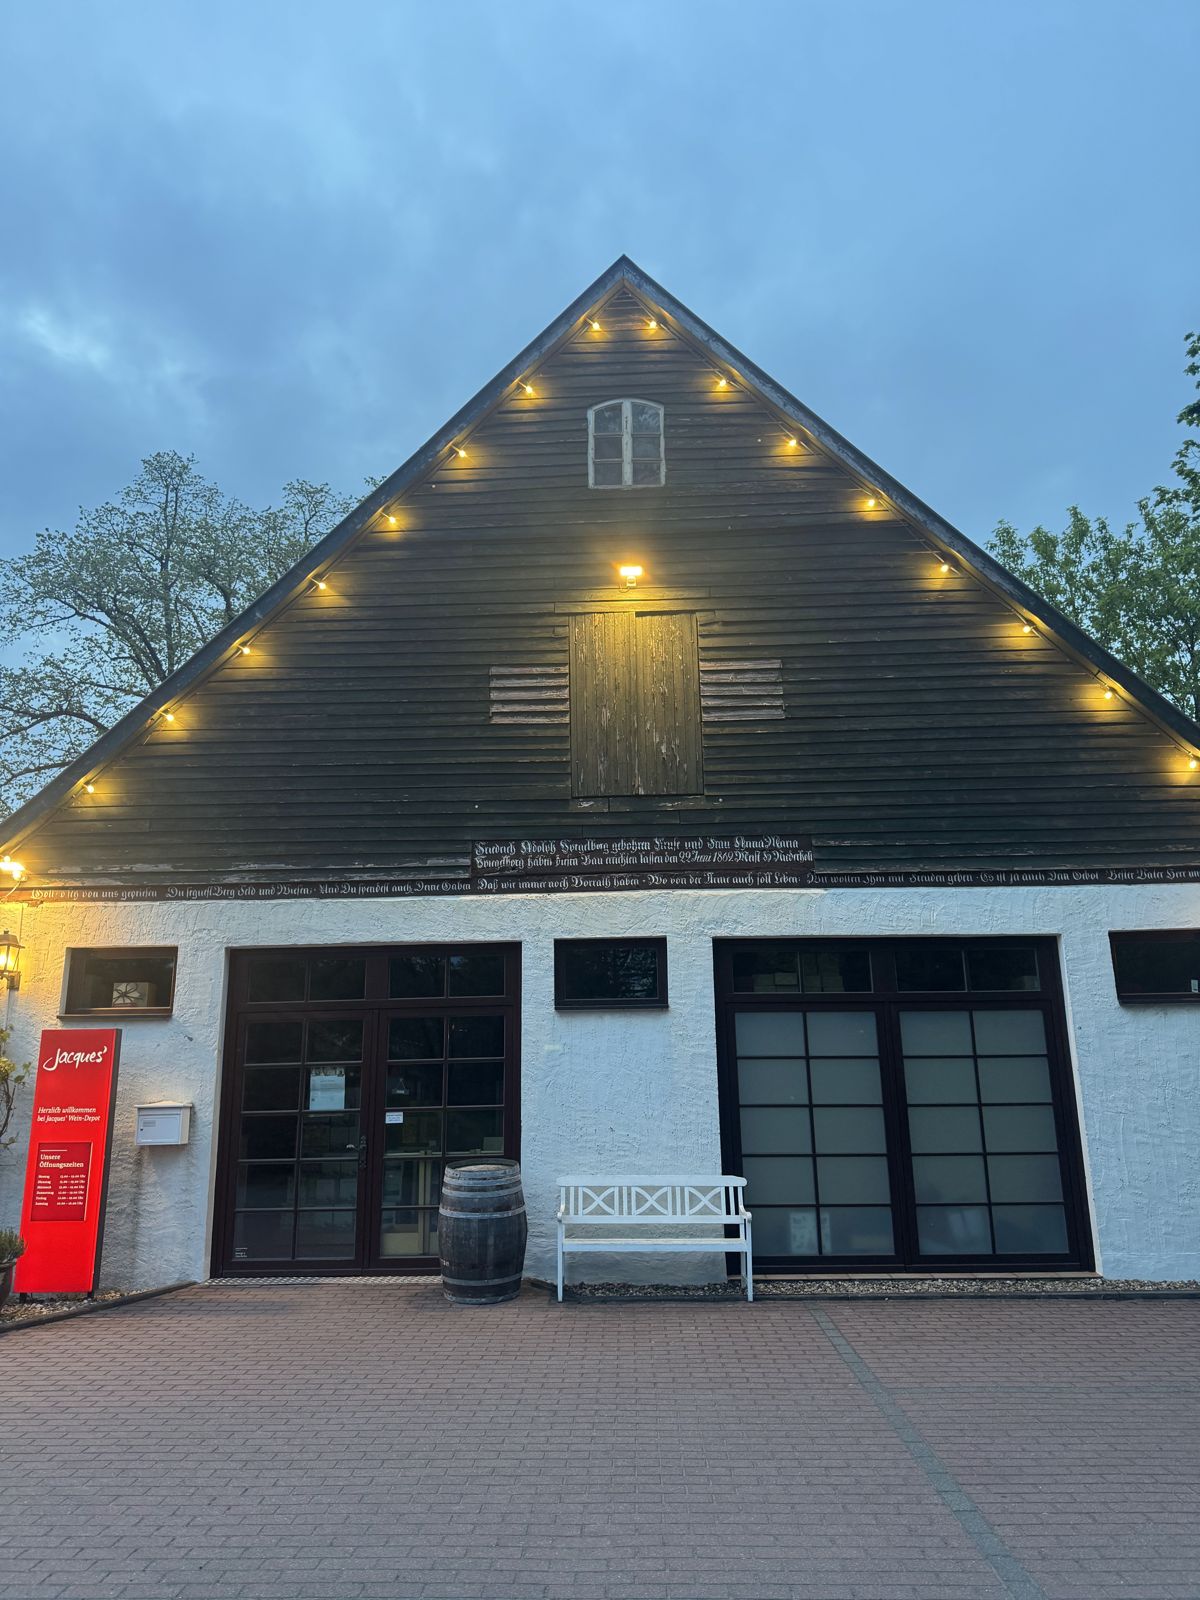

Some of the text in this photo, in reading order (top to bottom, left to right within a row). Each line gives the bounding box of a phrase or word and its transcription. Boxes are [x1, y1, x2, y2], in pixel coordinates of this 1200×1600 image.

[475, 841, 516, 856] Friedrich
[521, 840, 556, 855] Adolph
[684, 837, 703, 850] und
[528, 854, 552, 867] haben
[581, 853, 604, 865] Bau
[665, 850, 678, 863] den
[82, 889, 98, 898] von
[101, 889, 119, 898] uns
[166, 886, 184, 897] Du
[213, 885, 235, 898] Berg
[259, 884, 276, 896] und
[340, 882, 357, 894] Du
[391, 881, 414, 895] auch
[501, 878, 516, 889] wir
[518, 878, 546, 889] immer
[549, 876, 569, 890] noch
[613, 874, 639, 887] haben
[648, 873, 667, 885] Wo
[670, 874, 687, 885] von
[690, 873, 701, 884] der
[732, 872, 753, 885] auch
[756, 872, 772, 885] soll
[807, 872, 828, 884] Wir
[888, 872, 904, 882] mit
[947, 872, 973, 884] geben
[1021, 871, 1045, 883] auch
[1187, 869, 1200, 879] un
[38, 1106, 96, 1114] Herzlich willkommen
[68, 1114, 101, 1123] Wein-Depot
[39, 1161, 84, 1169] Öffnungszeiten
